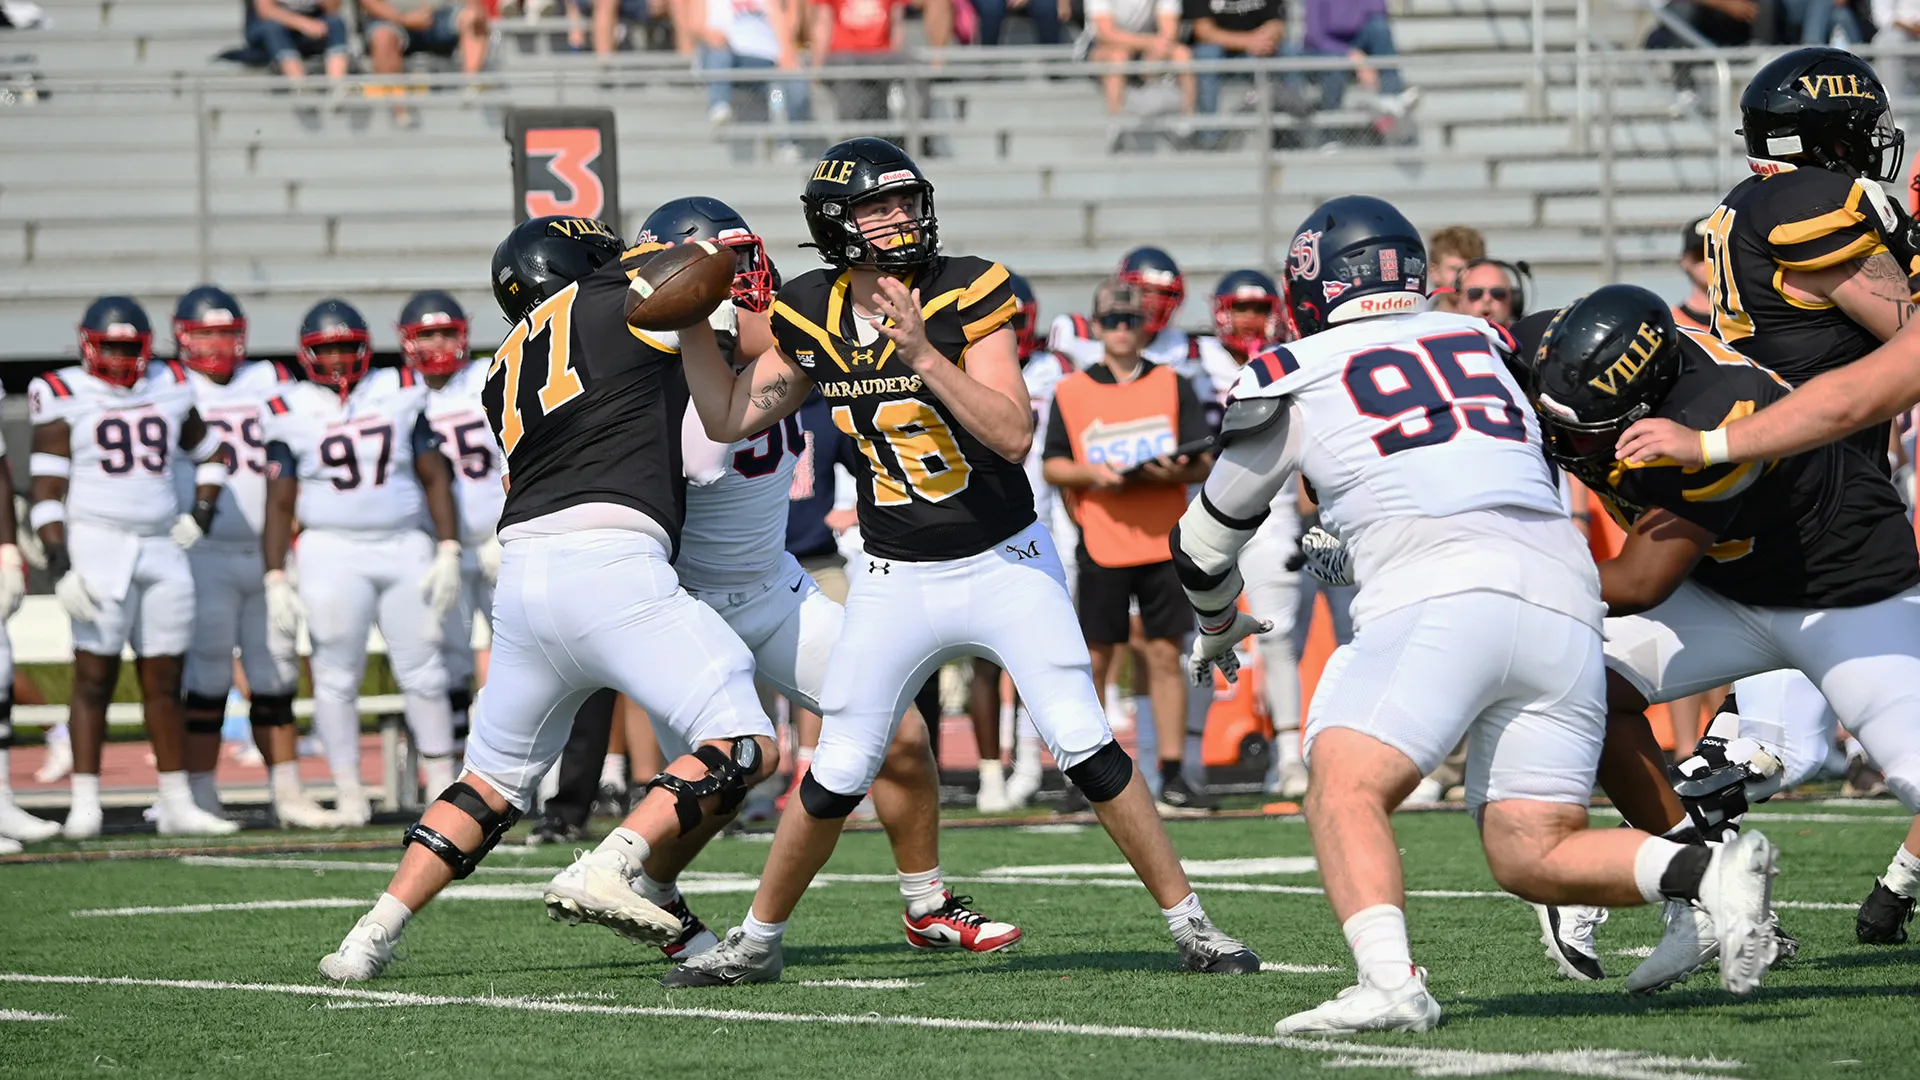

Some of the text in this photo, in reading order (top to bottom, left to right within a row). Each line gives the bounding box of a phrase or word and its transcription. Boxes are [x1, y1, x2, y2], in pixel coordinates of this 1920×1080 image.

[1798, 74, 1876, 99] VILL
[526, 128, 603, 219] 3
[809, 160, 856, 185] ILLE
[883, 171, 911, 181] Riddell
[509, 282, 520, 295] 77
[1360, 297, 1420, 312] Riddel
[488, 281, 585, 457] 77
[1588, 322, 1663, 395] VILLE
[818, 375, 922, 398] MARAUDERS
[1341, 331, 1527, 457] 95
[96, 416, 167, 474] 99
[320, 424, 392, 490] 97
[832, 397, 973, 506] 18
[415, 828, 449, 848] DONJOY
